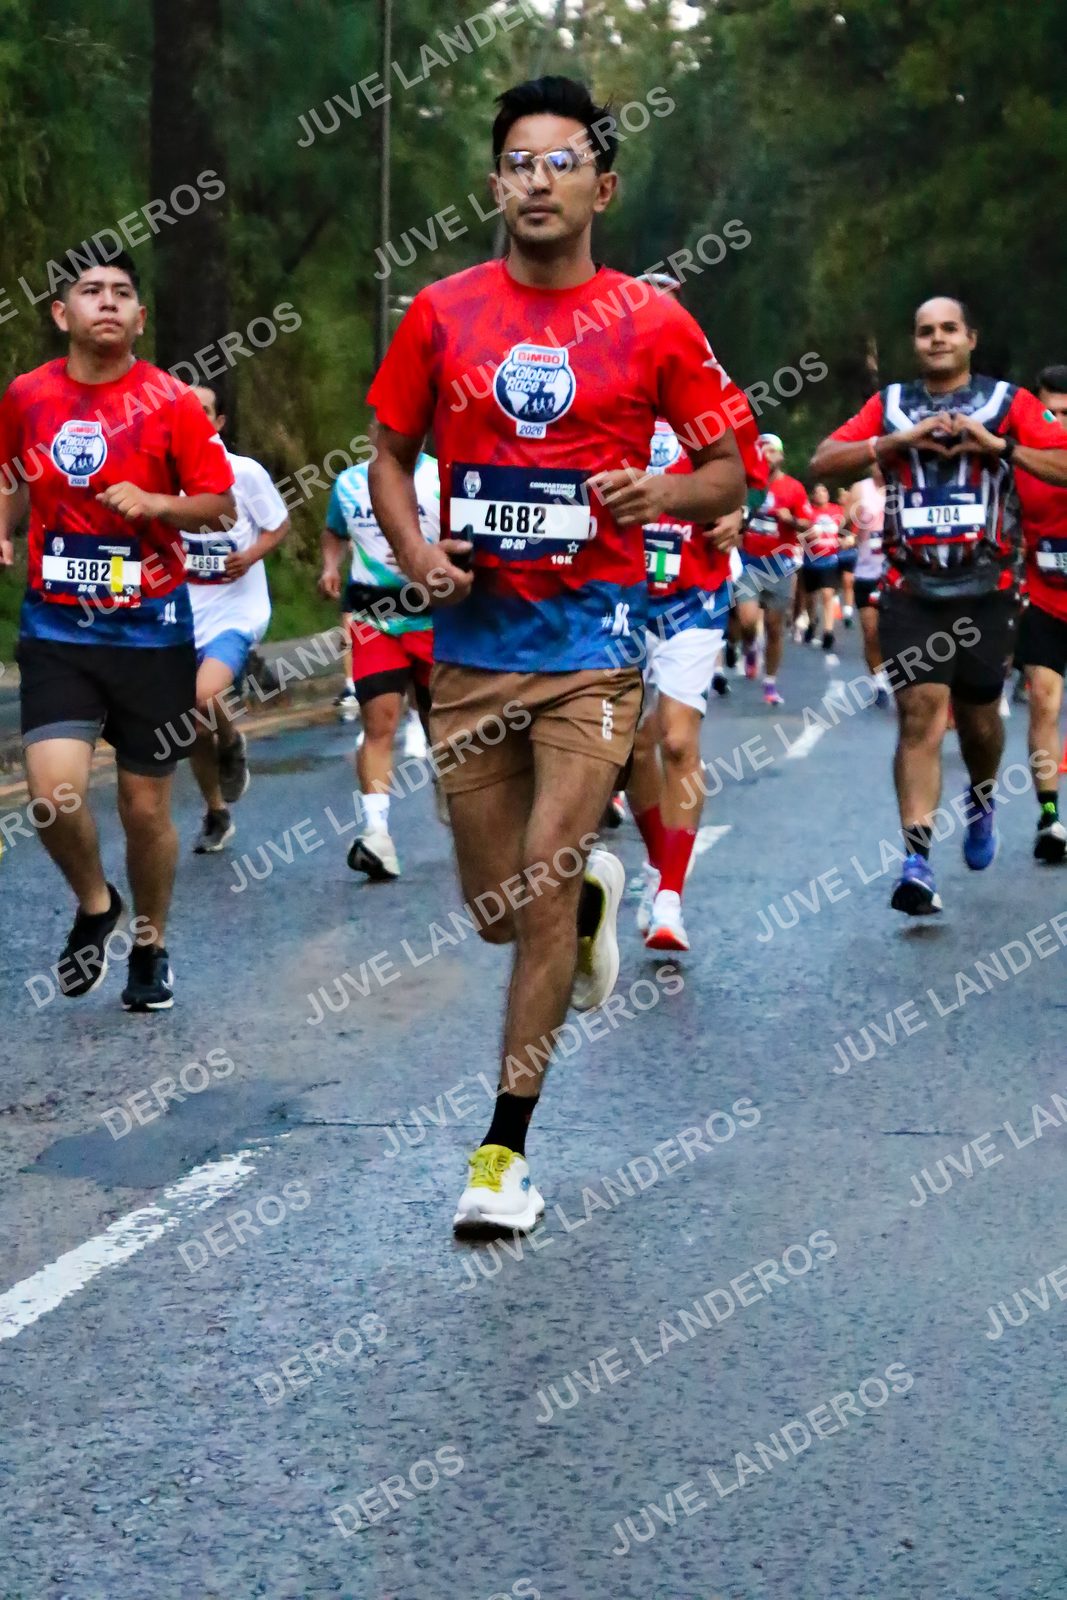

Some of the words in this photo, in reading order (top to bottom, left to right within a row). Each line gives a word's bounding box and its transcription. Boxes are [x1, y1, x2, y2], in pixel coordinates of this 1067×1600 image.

[515, 366, 559, 383] Global
[506, 377, 541, 392] Race
[484, 504, 547, 535] 4682
[926, 507, 961, 523] 4704
[551, 554, 573, 565] 10K
[66, 560, 111, 582] 5382
